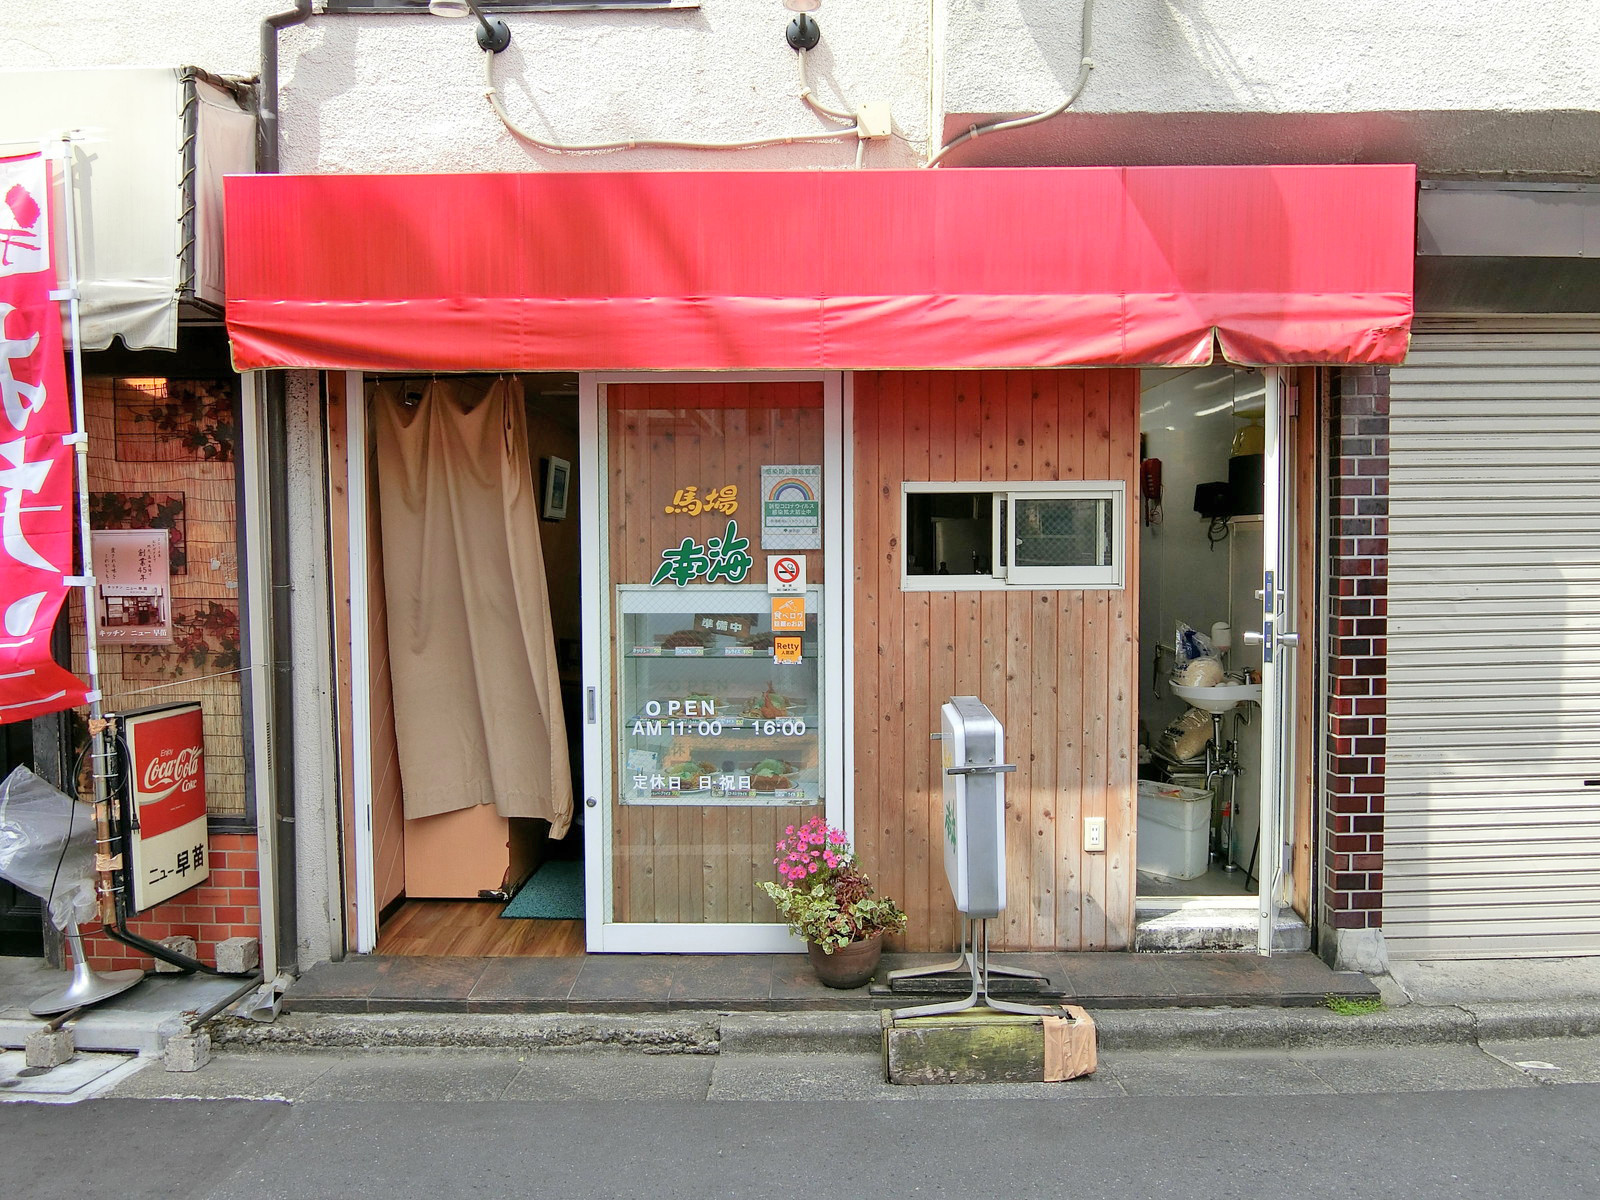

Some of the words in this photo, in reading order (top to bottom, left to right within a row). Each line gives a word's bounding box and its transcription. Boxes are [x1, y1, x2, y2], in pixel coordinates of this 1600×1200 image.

[665, 485, 738, 516] 馬場
[651, 520, 752, 588] 南海
[137, 548, 147, 582] 創業45年
[774, 611, 803, 619] 食べログ
[99, 629, 126, 637] キッチン
[702, 618, 742, 632] 準備中
[777, 643, 799, 651] Retty
[645, 700, 715, 716] OPEN
[632, 720, 662, 736] AM
[752, 720, 806, 736] 16:00
[160, 749, 174, 757] Enjoy
[144, 746, 203, 789] Coca-Cola
[182, 778, 198, 793] Coke
[633, 774, 681, 790] 定休日
[149, 843, 204, 885] ニュー早苗
